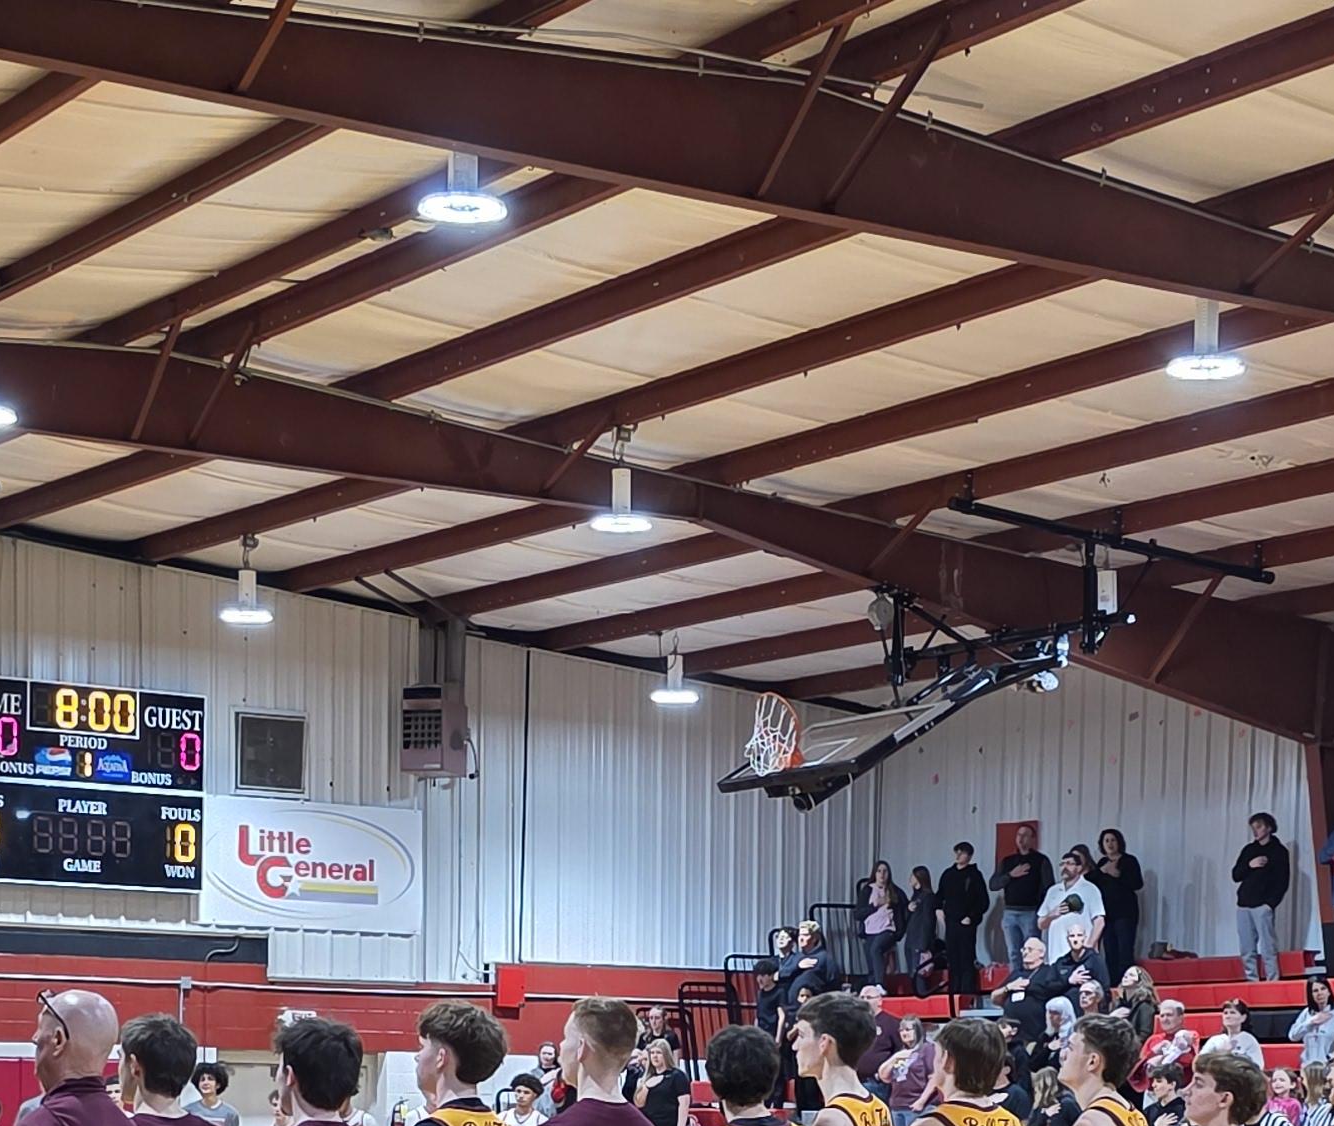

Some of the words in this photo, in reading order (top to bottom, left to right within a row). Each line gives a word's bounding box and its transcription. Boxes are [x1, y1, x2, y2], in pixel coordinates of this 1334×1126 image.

[55, 687, 136, 733] 8:00
[143, 705, 203, 731] GUEST
[59, 734, 108, 750] PERIOD
[131, 771, 172, 786] BONUS
[58, 799, 108, 816] PLAYER
[160, 806, 201, 823] FOULS
[238, 824, 312, 866] Little
[63, 858, 101, 873] GAME
[164, 864, 196, 880] WON
[256, 855, 375, 899] General
